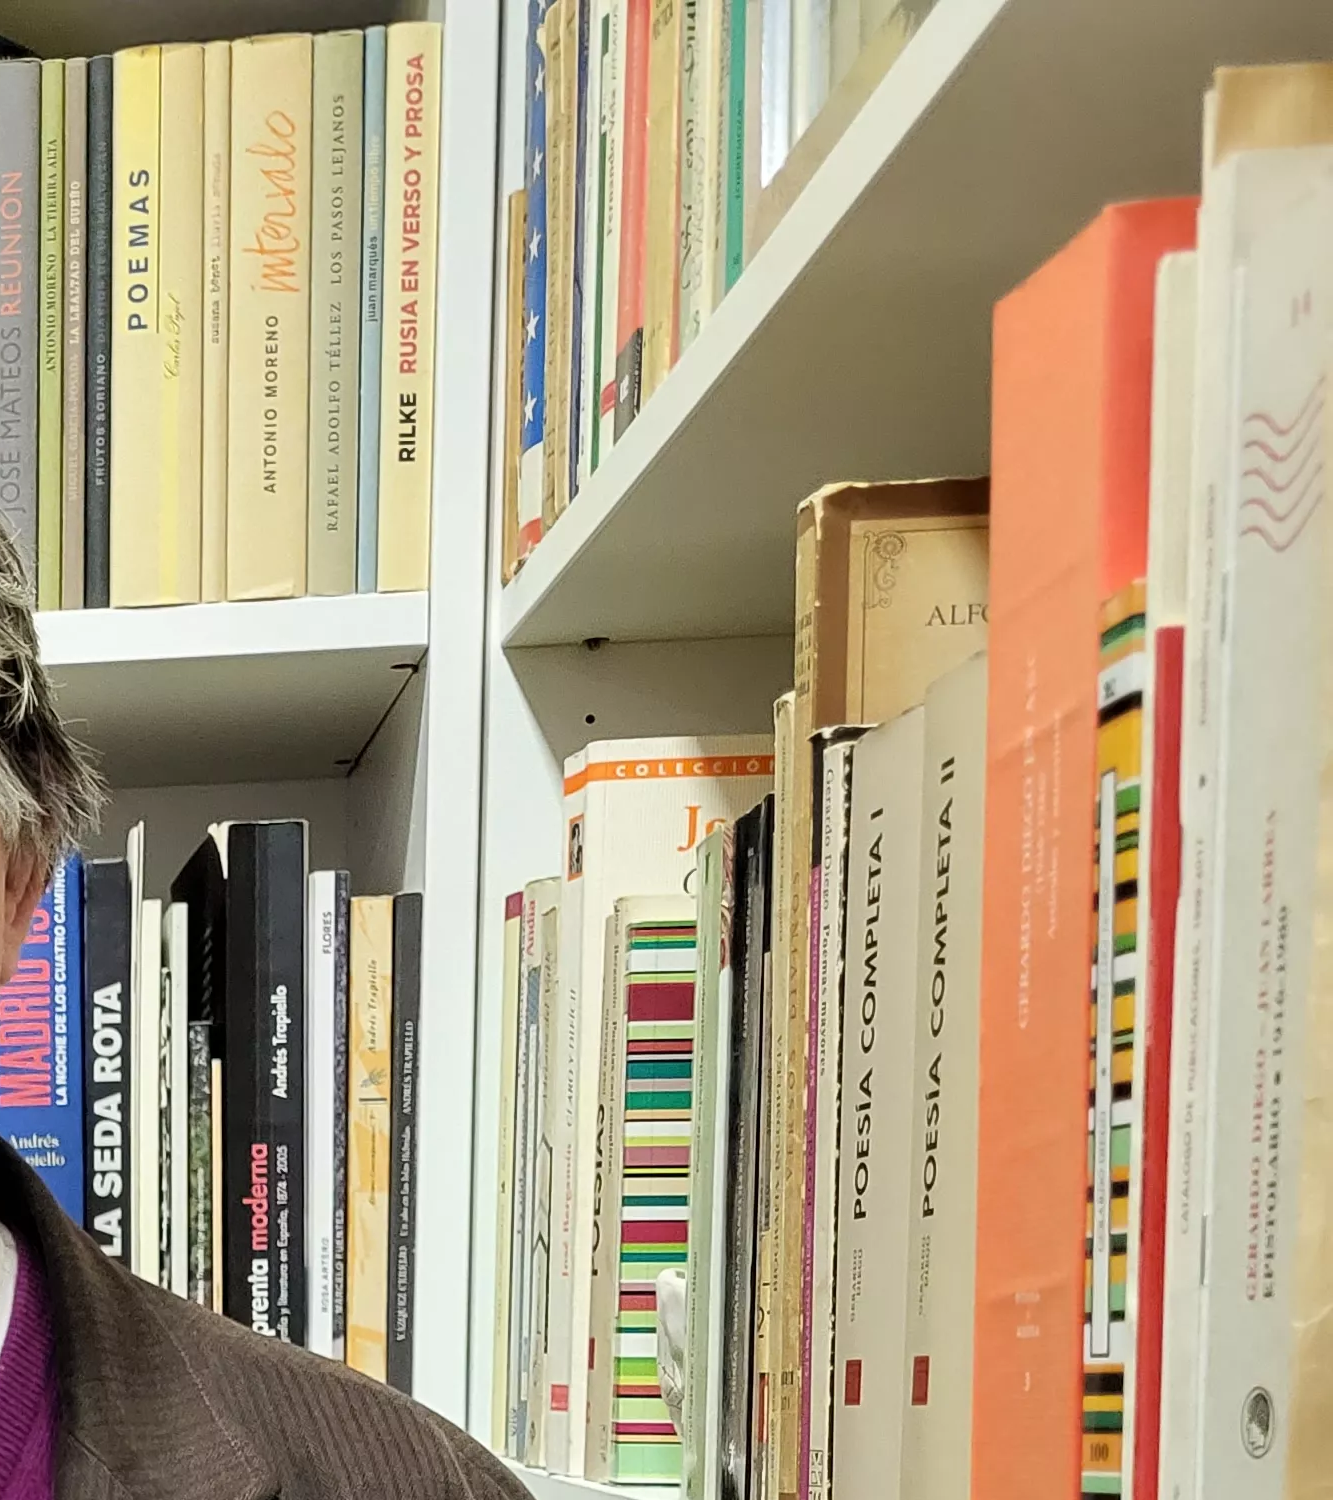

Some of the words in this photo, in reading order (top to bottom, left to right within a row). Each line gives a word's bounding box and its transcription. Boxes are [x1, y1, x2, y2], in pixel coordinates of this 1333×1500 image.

[331, 93, 347, 177] LEJANOS
[404, 52, 425, 138] PROSA
[403, 145, 423, 163] Y
[241, 110, 302, 293] intervalo
[330, 184, 345, 242] PASOS
[401, 169, 423, 253] VERSO
[127, 168, 151, 332] POEMAS
[330, 250, 344, 285] LOS
[400, 259, 421, 293] EN
[263, 314, 280, 399] MORENO
[324, 300, 343, 372] TÉLLEZ
[399, 299, 420, 374] RUSIA
[0, 326, 22, 441] MATEOS
[327, 379, 341, 456] ADOLFO
[262, 408, 279, 495] ANTONIO
[398, 392, 419, 463] RILKE
[326, 464, 340, 533] RAFAEL
[939, 755, 956, 785] II
[1258, 808, 1277, 927] LARREA
[322, 911, 333, 955] FLORES
[859, 832, 884, 1055] COMPLETA
[929, 797, 954, 1039] COMPLETA
[92, 981, 122, 1083] ROTA
[271, 984, 292, 1045] Trapiello
[366, 1015, 379, 1054] Andrés
[270, 1047, 289, 1099] Andrés
[1246, 1046, 1267, 1144] DIEGO
[10, 1132, 60, 1150] Andrés
[92, 1092, 123, 1198] SEDA
[852, 1067, 873, 1221] POESÍA
[921, 1052, 943, 1219] POESÍA
[93, 1207, 123, 1257] LA
[242, 1143, 270, 1252] moderna
[1244, 1155, 1263, 1302] GERARDO
[1260, 1096, 1283, 1299] EPISTOLARIO
[248, 1258, 276, 1337] prenta
